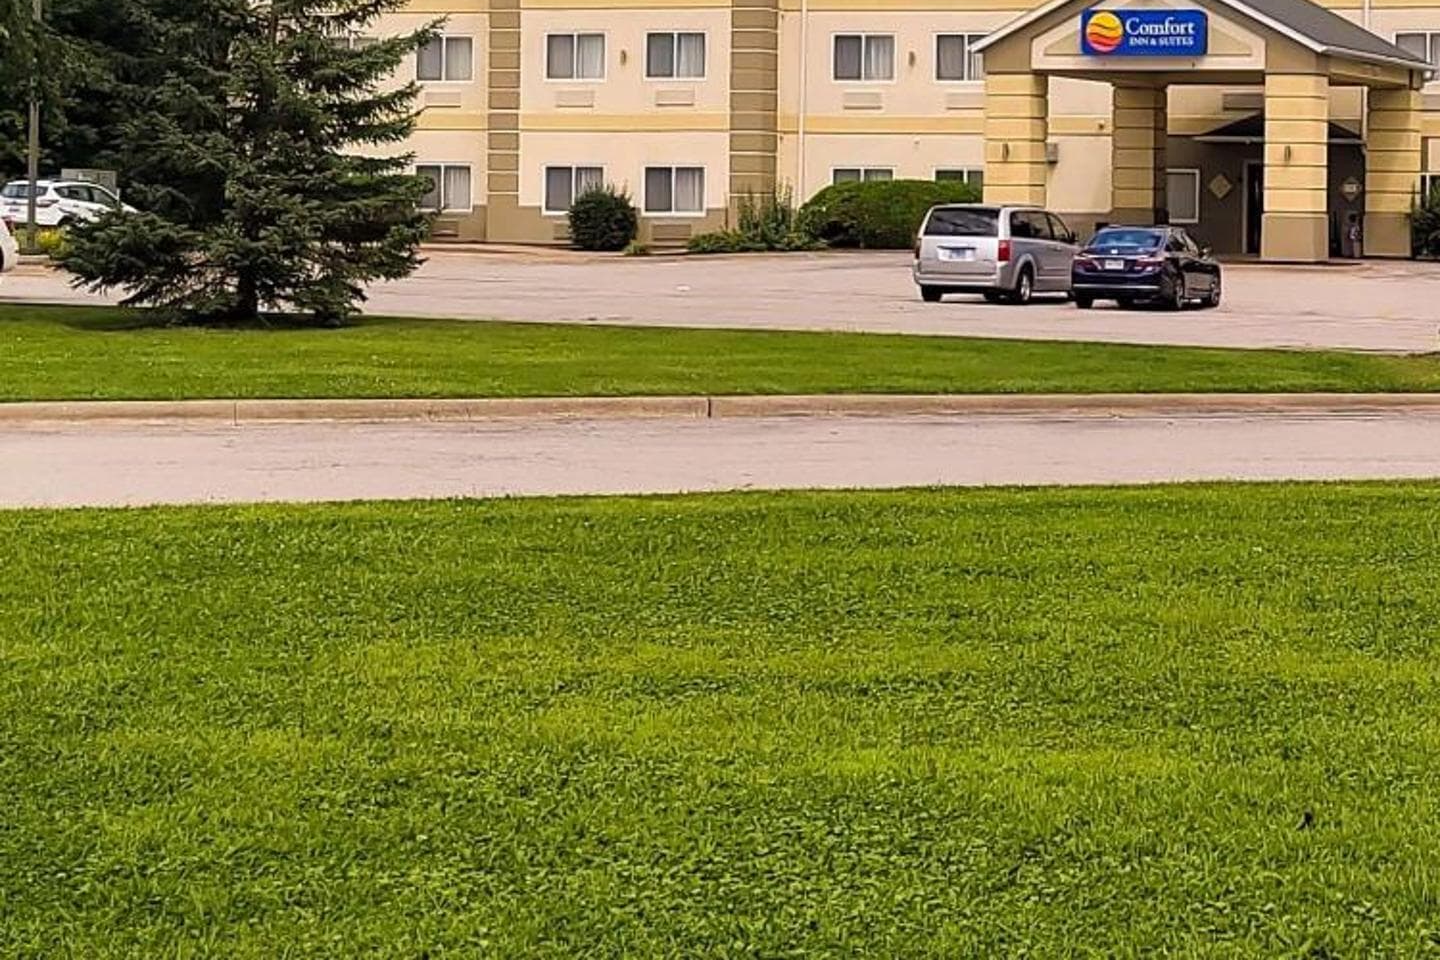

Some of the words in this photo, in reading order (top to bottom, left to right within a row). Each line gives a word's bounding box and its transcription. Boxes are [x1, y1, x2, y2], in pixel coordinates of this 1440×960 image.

[1125, 16, 1196, 35] Comfort
[1129, 36, 1148, 46] INN
[1159, 36, 1194, 46] SUITES
